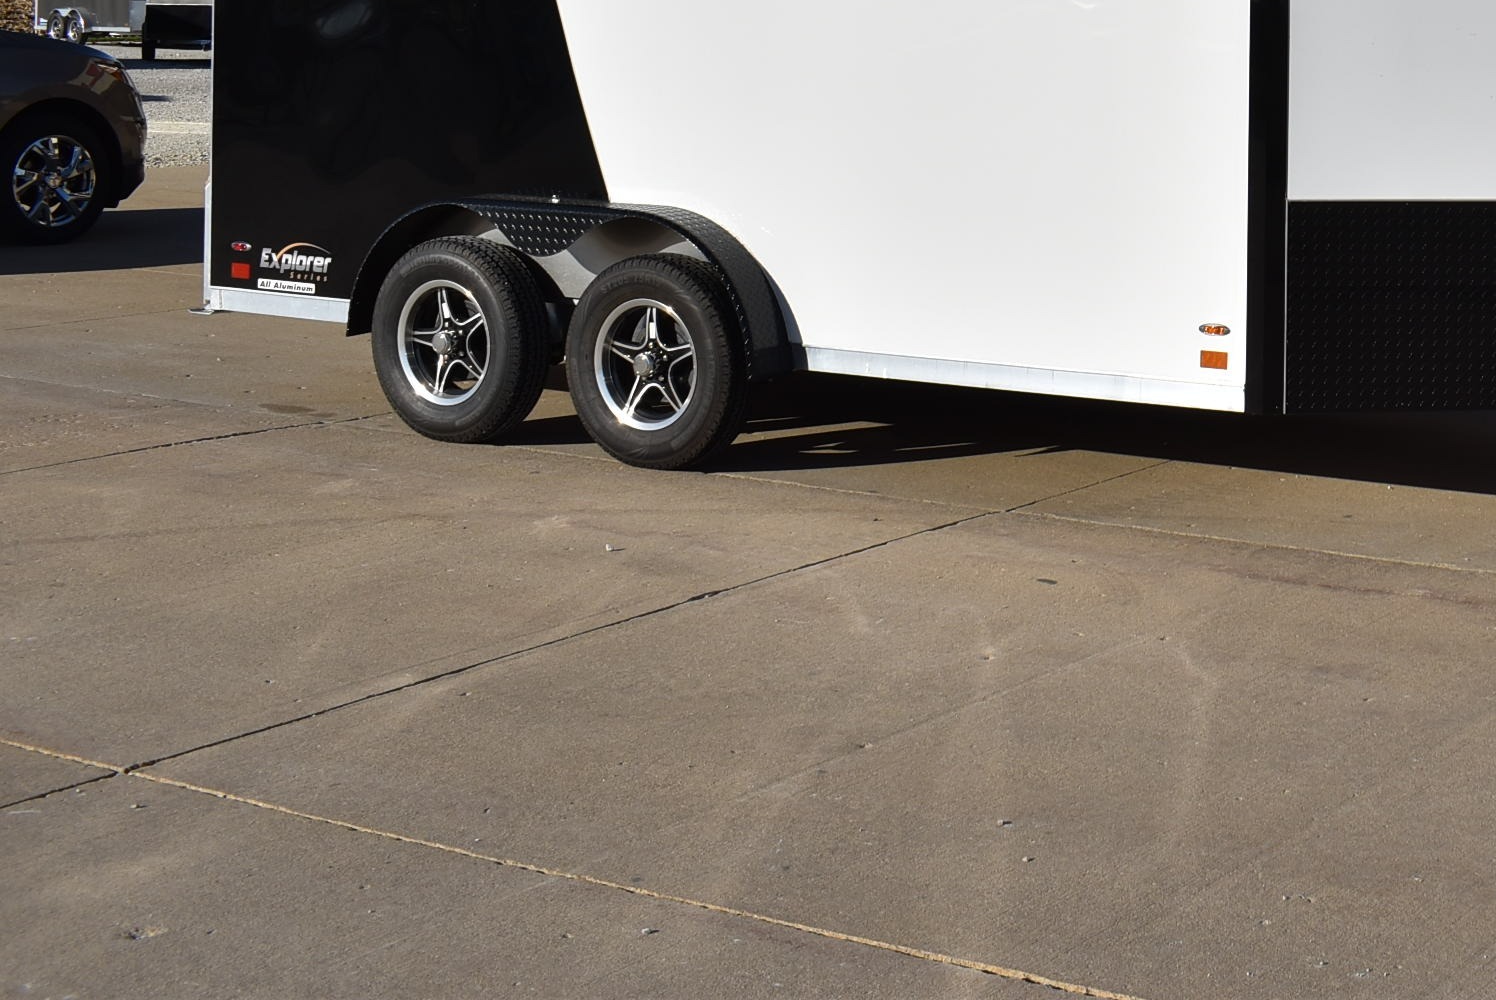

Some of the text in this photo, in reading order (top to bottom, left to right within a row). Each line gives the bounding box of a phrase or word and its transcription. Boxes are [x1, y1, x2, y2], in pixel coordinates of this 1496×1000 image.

[260, 248, 332, 273] Explorer
[290, 272, 327, 282] Series
[274, 283, 313, 292] Aluminum
